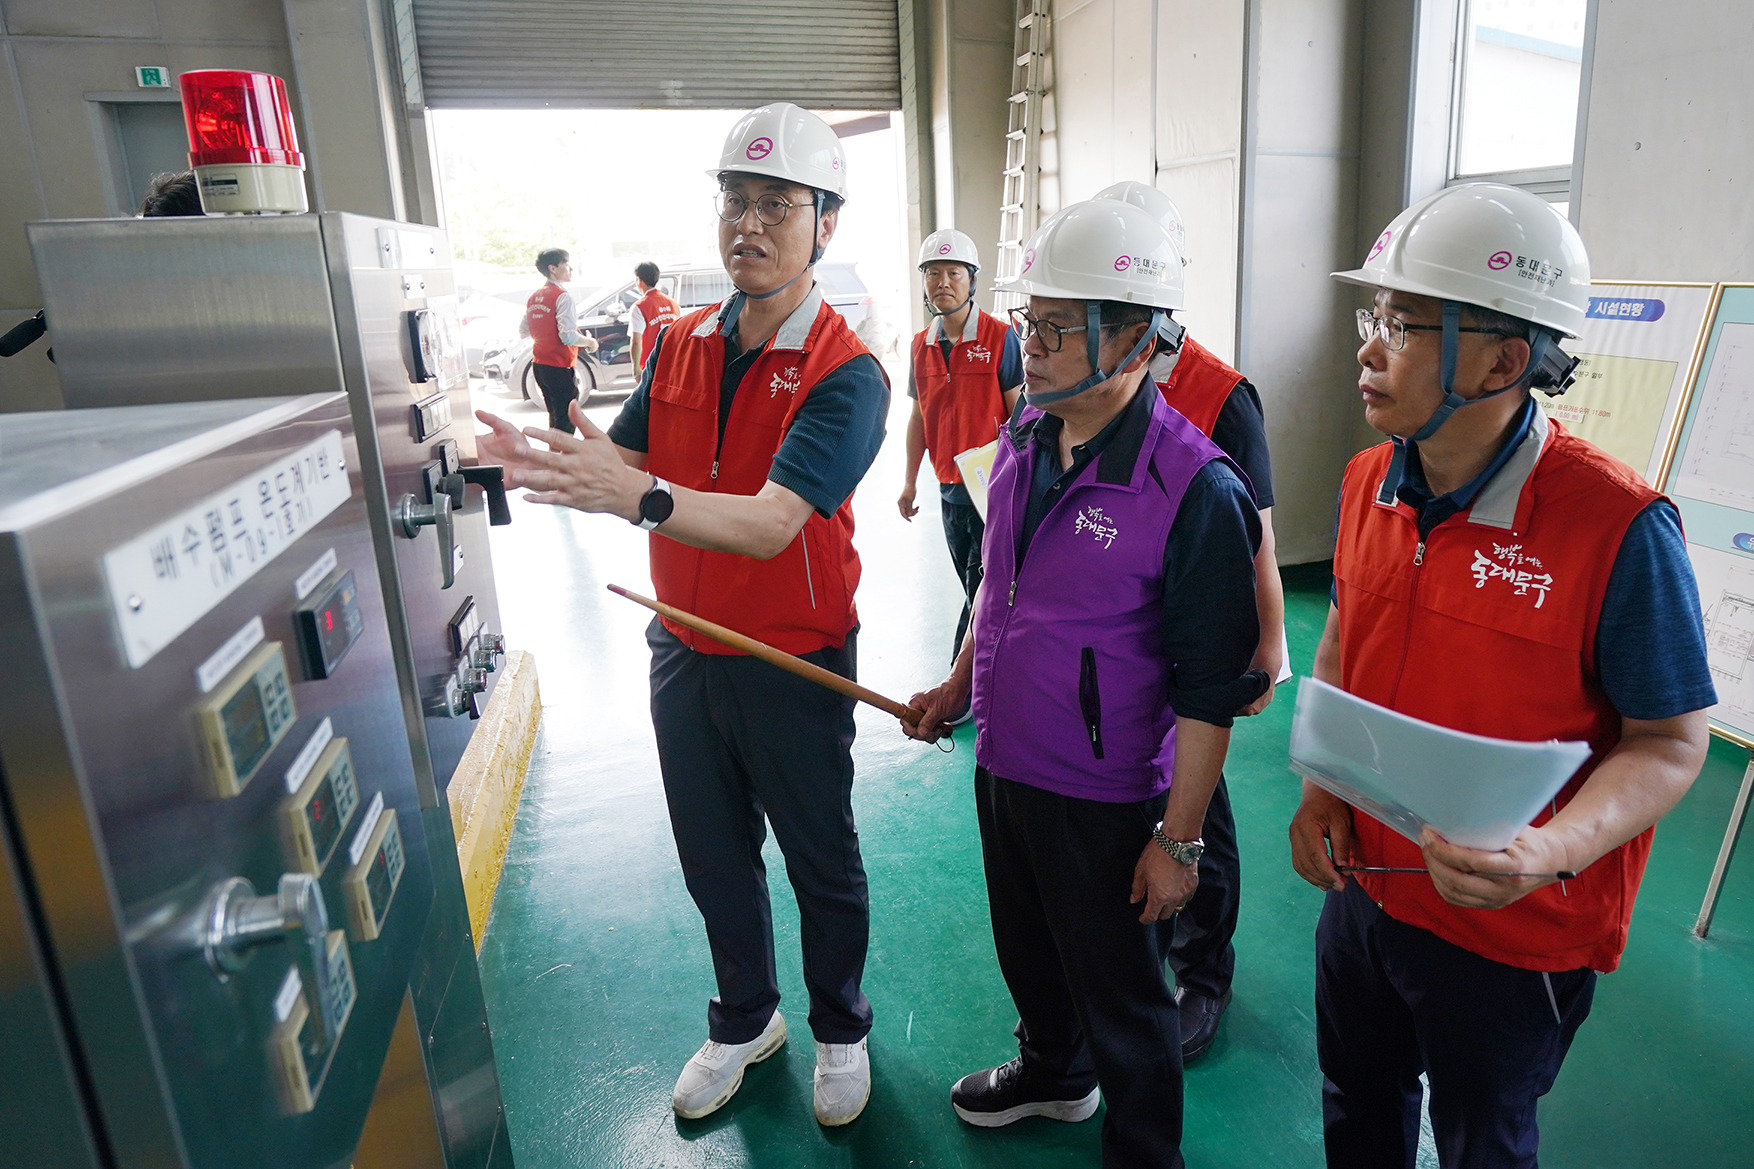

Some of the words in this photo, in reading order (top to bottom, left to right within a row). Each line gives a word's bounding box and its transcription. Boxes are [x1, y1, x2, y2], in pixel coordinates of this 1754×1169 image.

[1133, 256, 1166, 271] 동대문구
[1516, 255, 1563, 280] 동대문구
[1594, 301, 1645, 317] 시설현황
[150, 497, 247, 581] 배수펌프
[257, 447, 330, 519] 온도계기반
[1075, 509, 1118, 549] 동대문구
[1492, 542, 1524, 566] 행복을
[1525, 556, 1543, 570] 여는
[1471, 549, 1553, 609] 동대문구
